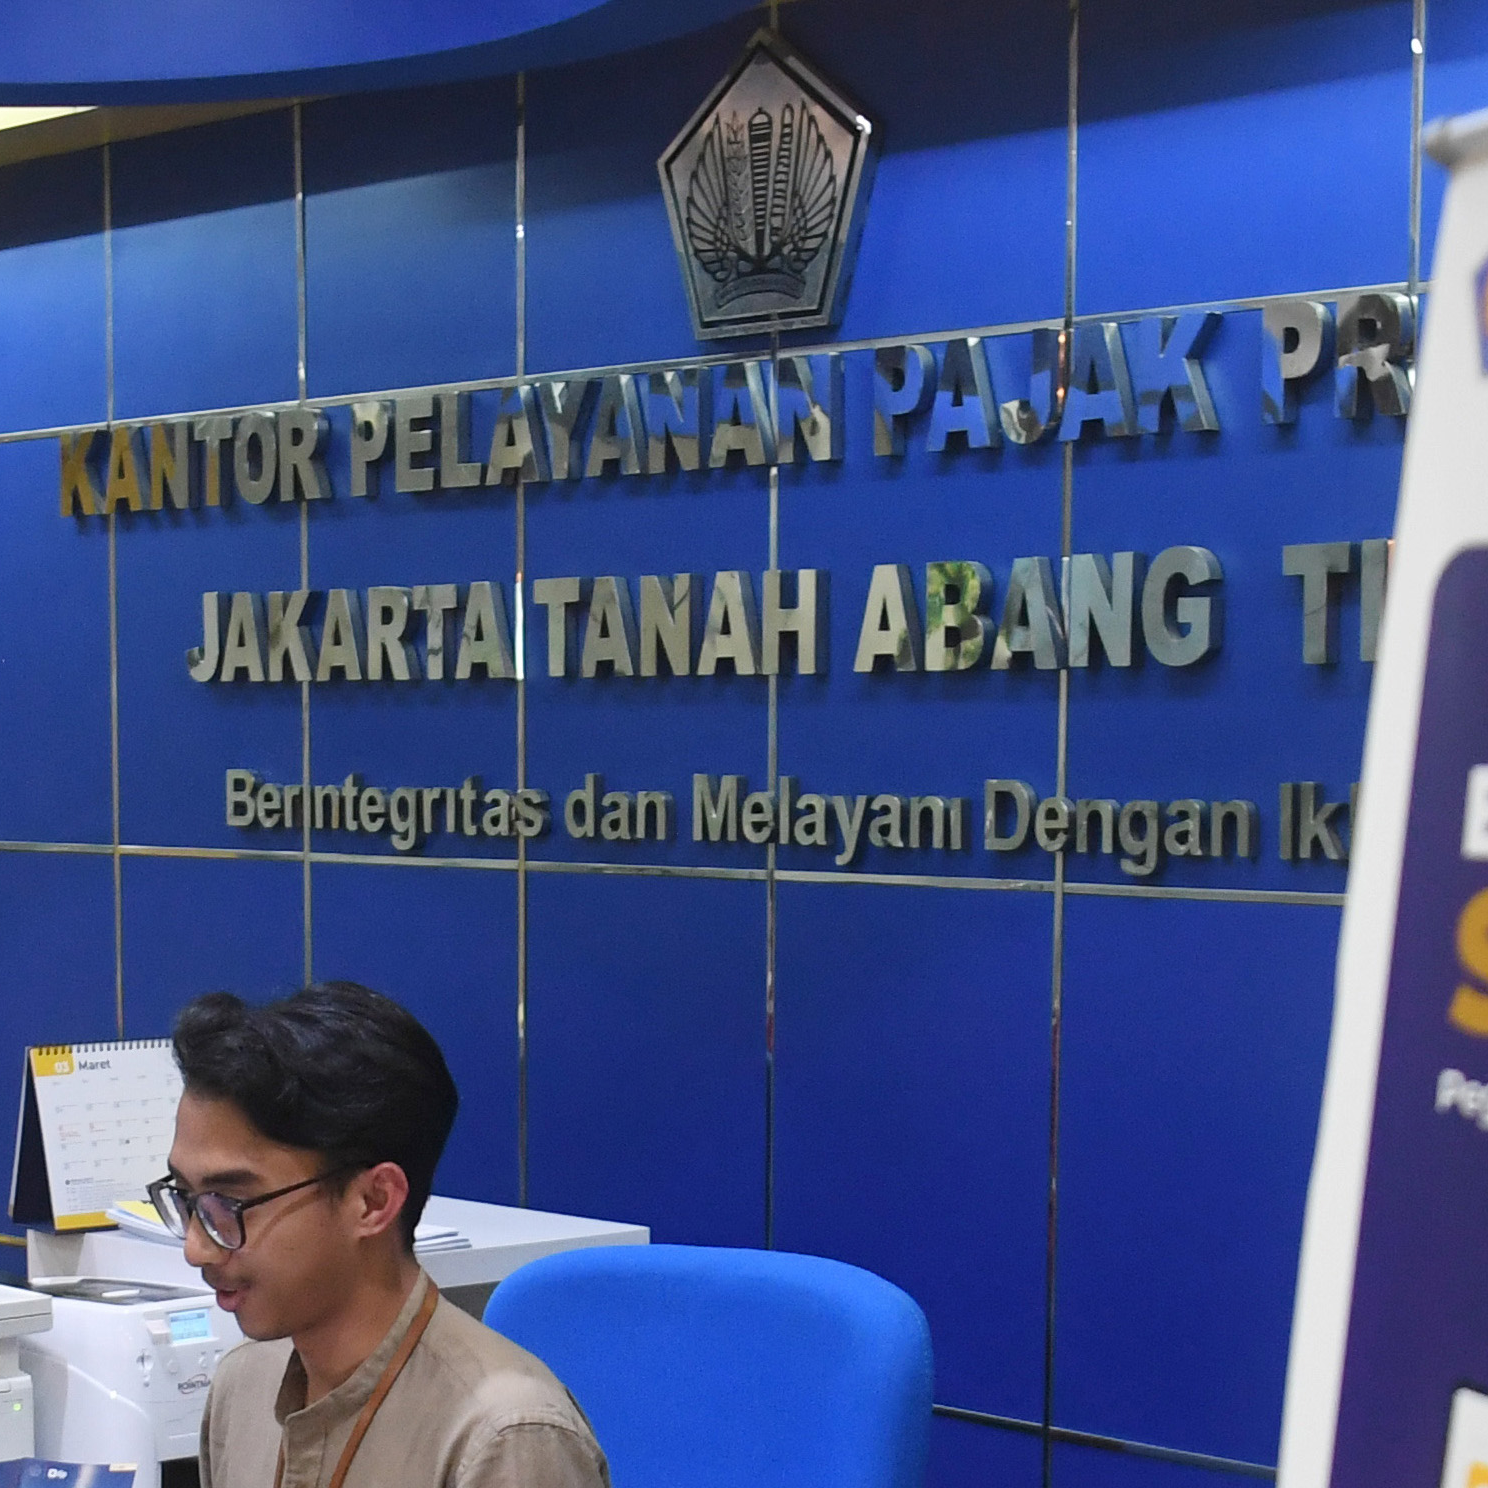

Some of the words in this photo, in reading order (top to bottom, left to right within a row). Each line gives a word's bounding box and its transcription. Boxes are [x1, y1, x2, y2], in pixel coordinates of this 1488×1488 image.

[59, 406, 330, 518] KANTOR
[351, 352, 842, 498] PELAYANAN
[873, 311, 1221, 457] PAJAK
[187, 581, 518, 683] JAKARTA
[533, 568, 827, 677] TANAH
[854, 545, 1221, 673] ABANG
[225, 769, 548, 850] Berintegritas
[564, 773, 671, 841] dan
[692, 773, 963, 866] Melayani
[984, 779, 1259, 877] Dengan
[78, 1059, 112, 1071] Maret
